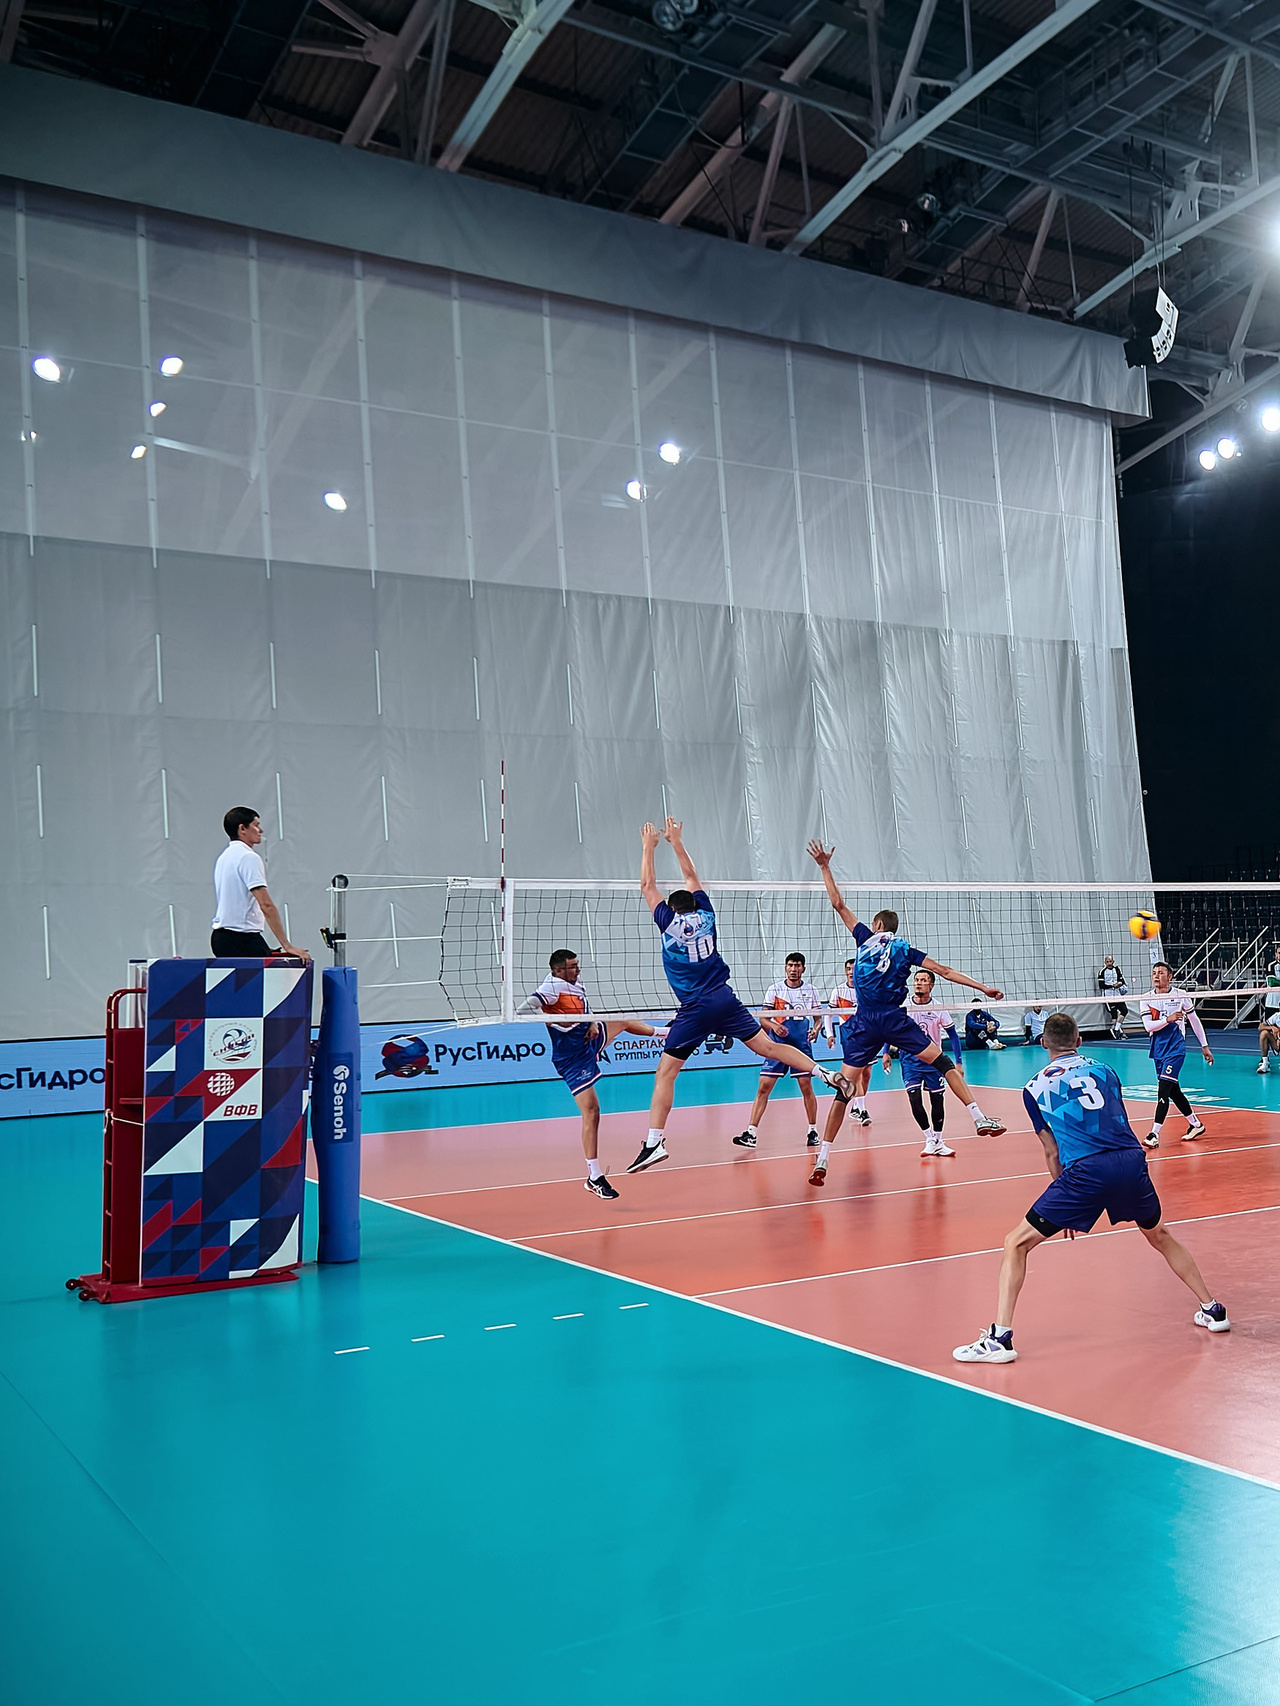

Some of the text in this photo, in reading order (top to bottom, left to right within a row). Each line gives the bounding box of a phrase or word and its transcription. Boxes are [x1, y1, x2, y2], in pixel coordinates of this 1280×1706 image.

[686, 935, 714, 962] 10
[434, 1041, 546, 1066] РусГидро
[614, 1051, 651, 1061] ГРУППЫ
[1165, 1064, 1173, 1075] 5
[1069, 1076, 1105, 1110] 3
[223, 1104, 259, 1117] ВФВ
[333, 1082, 347, 1140] Senoh
